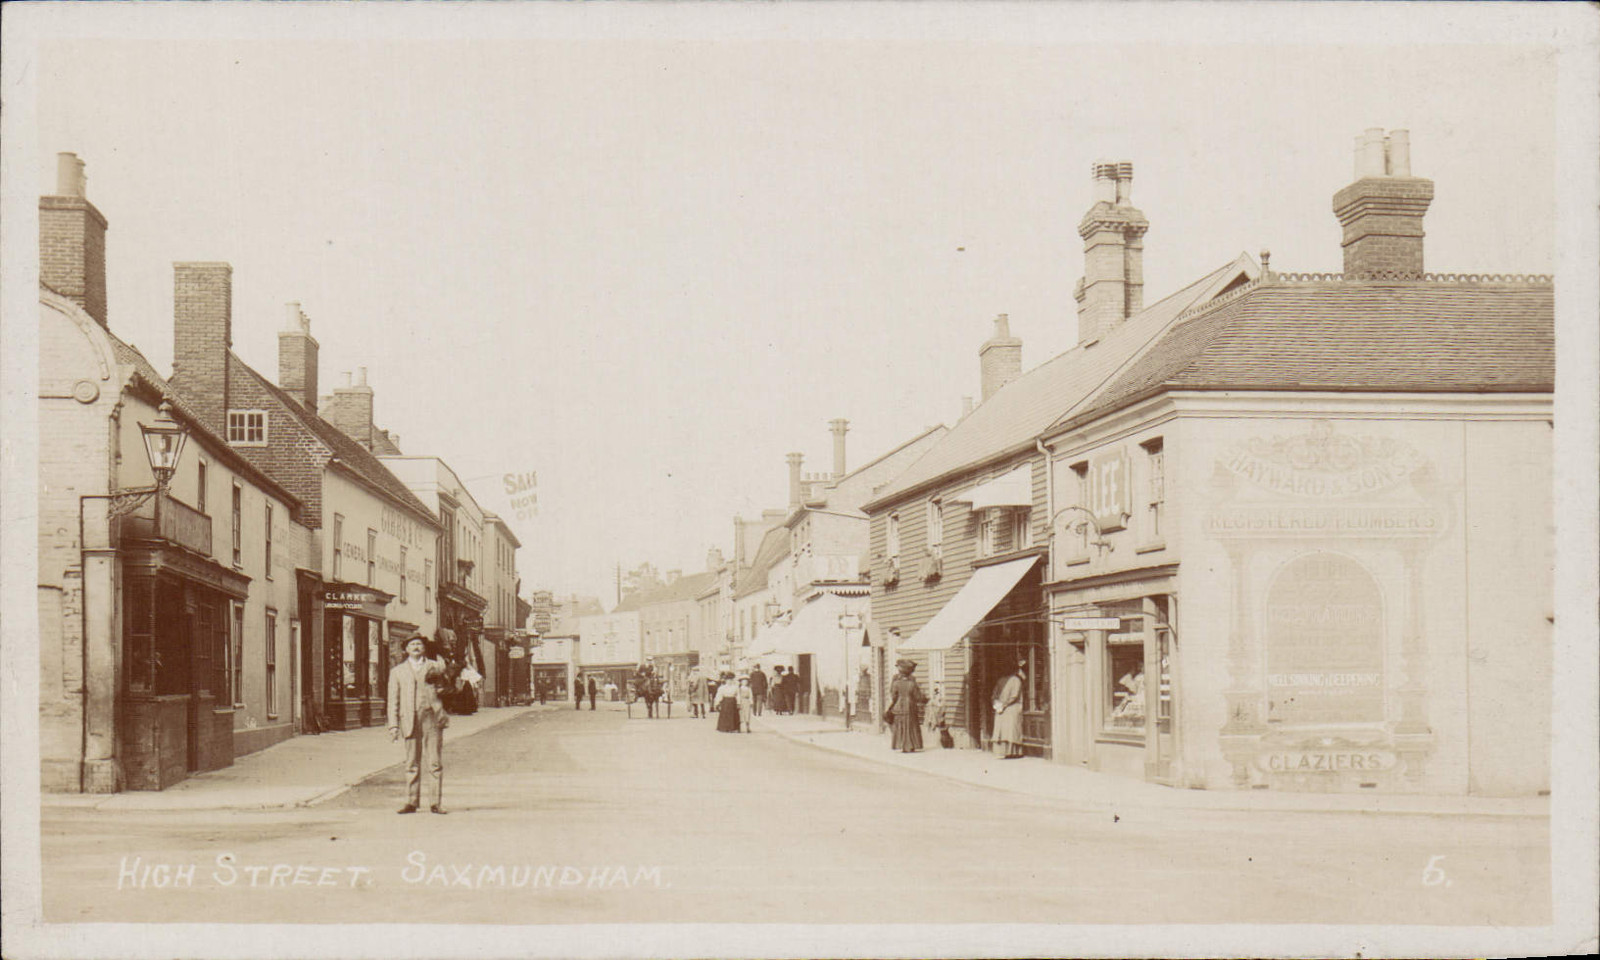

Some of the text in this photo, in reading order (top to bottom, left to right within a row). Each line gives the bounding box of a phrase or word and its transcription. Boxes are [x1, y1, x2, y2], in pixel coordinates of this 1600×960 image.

[1223, 453, 1407, 495] HAYWARD & SONS
[1208, 510, 1437, 530] REGISTERED PLUMBERS
[325, 592, 368, 602] CLARKE
[1268, 753, 1382, 771] GLAZIERS
